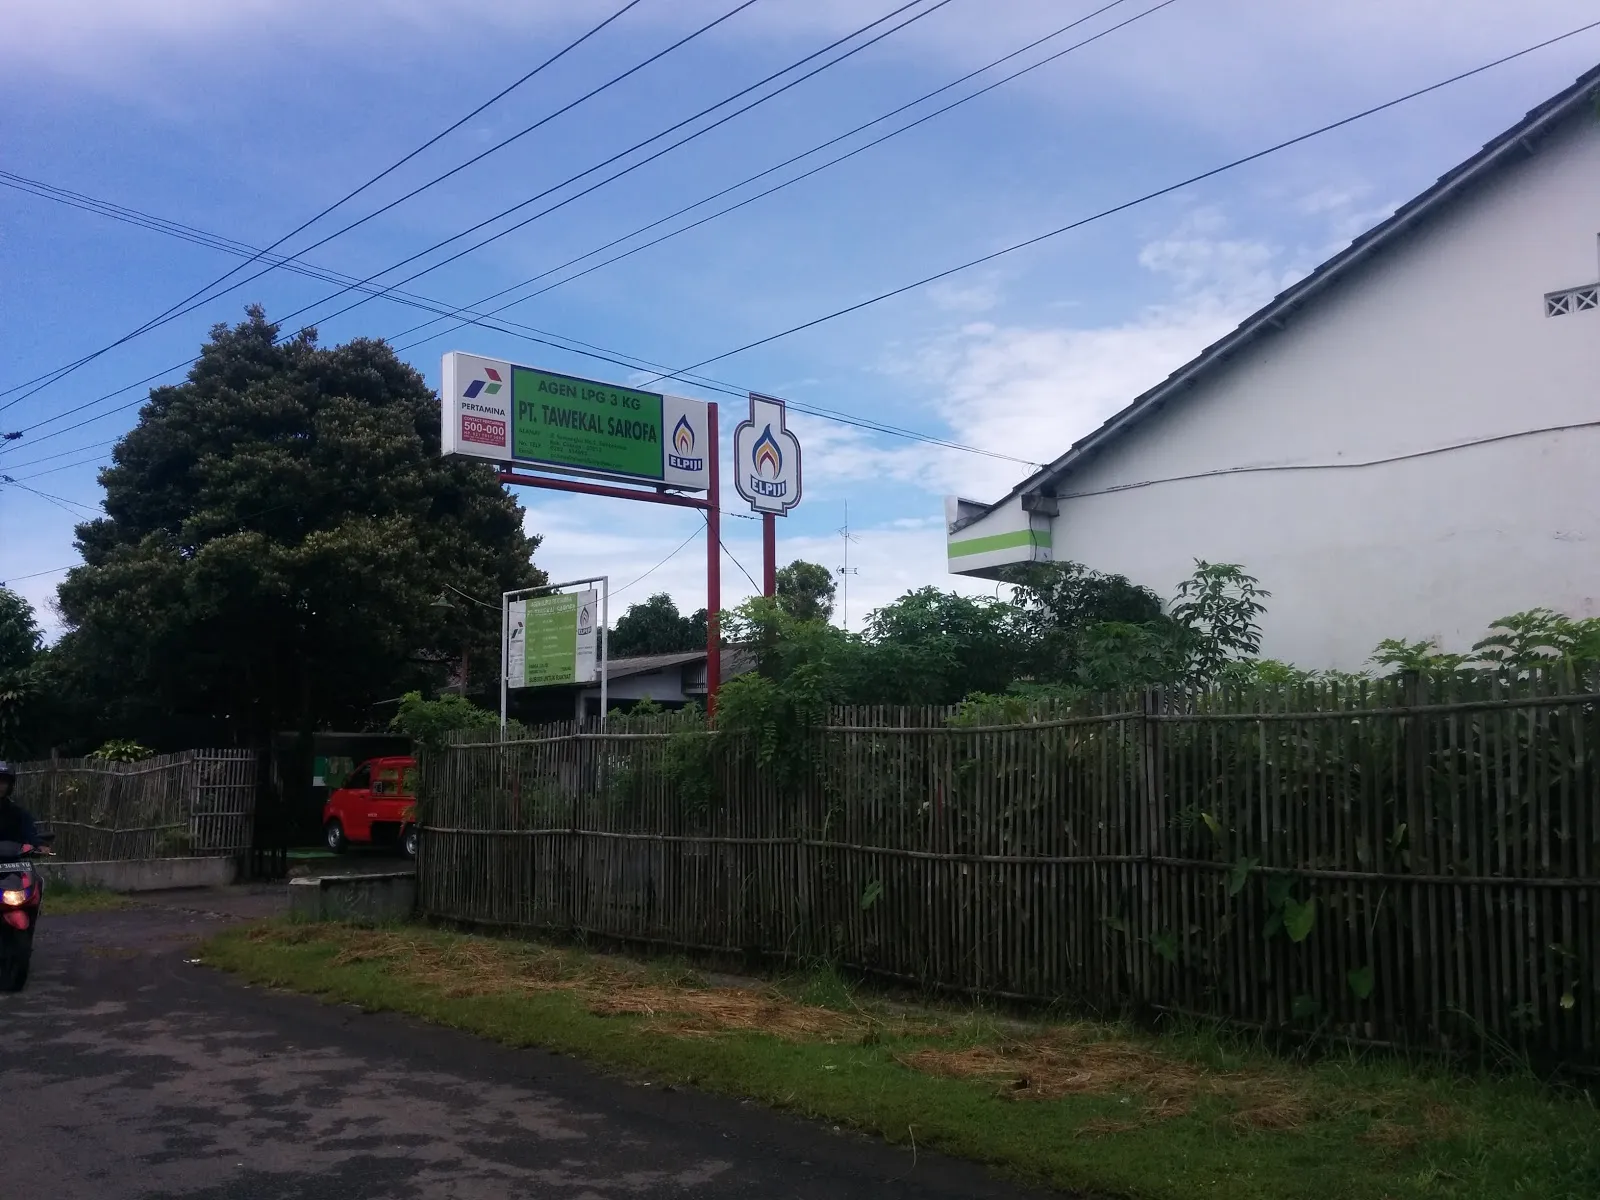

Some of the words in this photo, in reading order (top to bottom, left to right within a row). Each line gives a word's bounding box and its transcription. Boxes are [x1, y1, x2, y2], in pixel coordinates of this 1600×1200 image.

[538, 380, 577, 398] AGEN
[582, 388, 606, 404] LPG
[610, 393, 618, 406] 3
[622, 395, 641, 410] KG
[461, 402, 506, 416] PERTAMINA
[464, 421, 504, 436] 500-000
[519, 400, 537, 423] PT.
[542, 404, 604, 434] TAWEKAL
[607, 416, 657, 443] SAROFA
[670, 456, 702, 471] ELPIJI
[752, 480, 785, 497] ELPIJI
